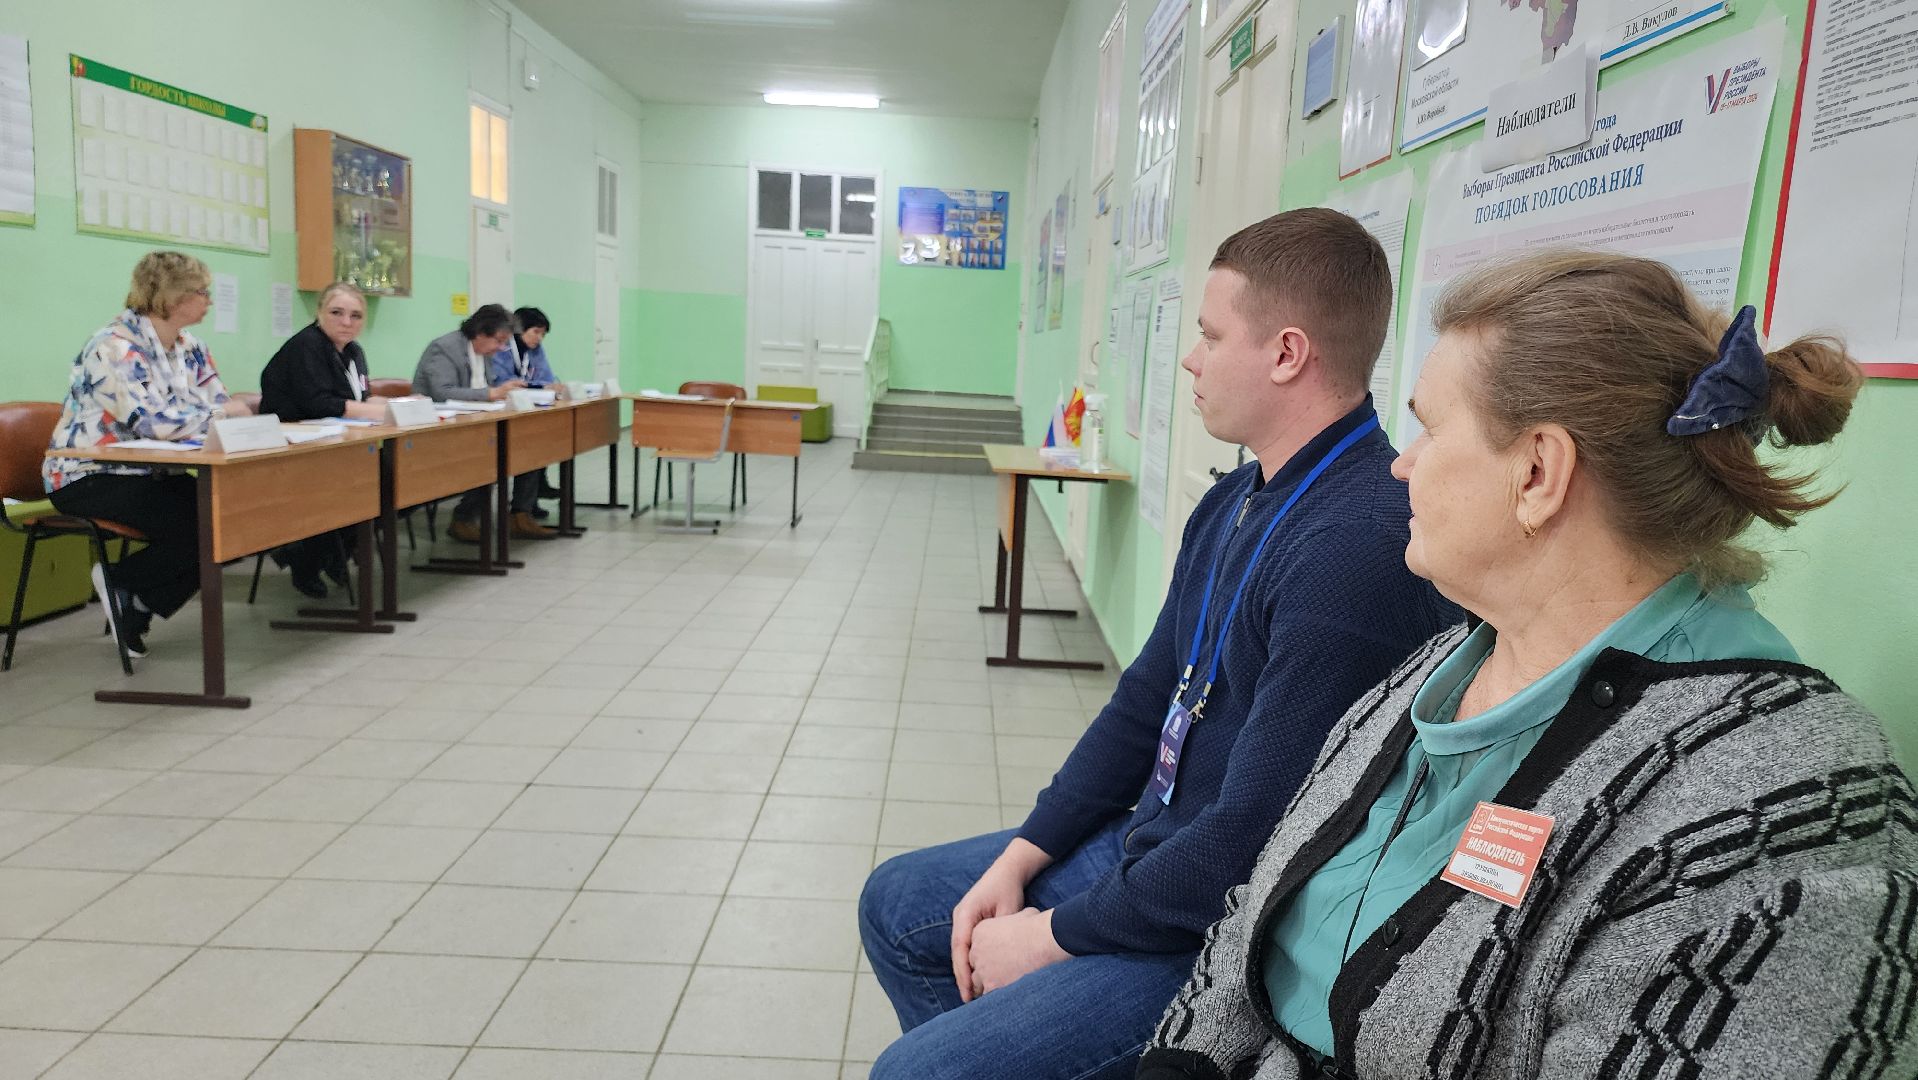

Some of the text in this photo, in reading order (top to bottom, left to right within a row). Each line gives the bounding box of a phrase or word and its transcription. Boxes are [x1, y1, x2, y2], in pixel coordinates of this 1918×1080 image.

[1641, 7, 1678, 32] Вакулов
[1727, 67, 1767, 88] ПРЕЗИДЕНТА
[1732, 57, 1761, 75] ВЫБОРЫ
[130, 75, 187, 105] ГОРДОСТЬ
[1722, 84, 1749, 101] РОССИИ
[1496, 92, 1577, 138] Наблюдатели
[1595, 113, 1617, 132] года
[1463, 118, 1684, 199] Выборы Президента Российской Федерации
[1475, 163, 1645, 224] ПОРЯДОК ГОЛОСОВАНИЯ
[1465, 836, 1527, 867] НАБЛЮДАТЕЛЬ
